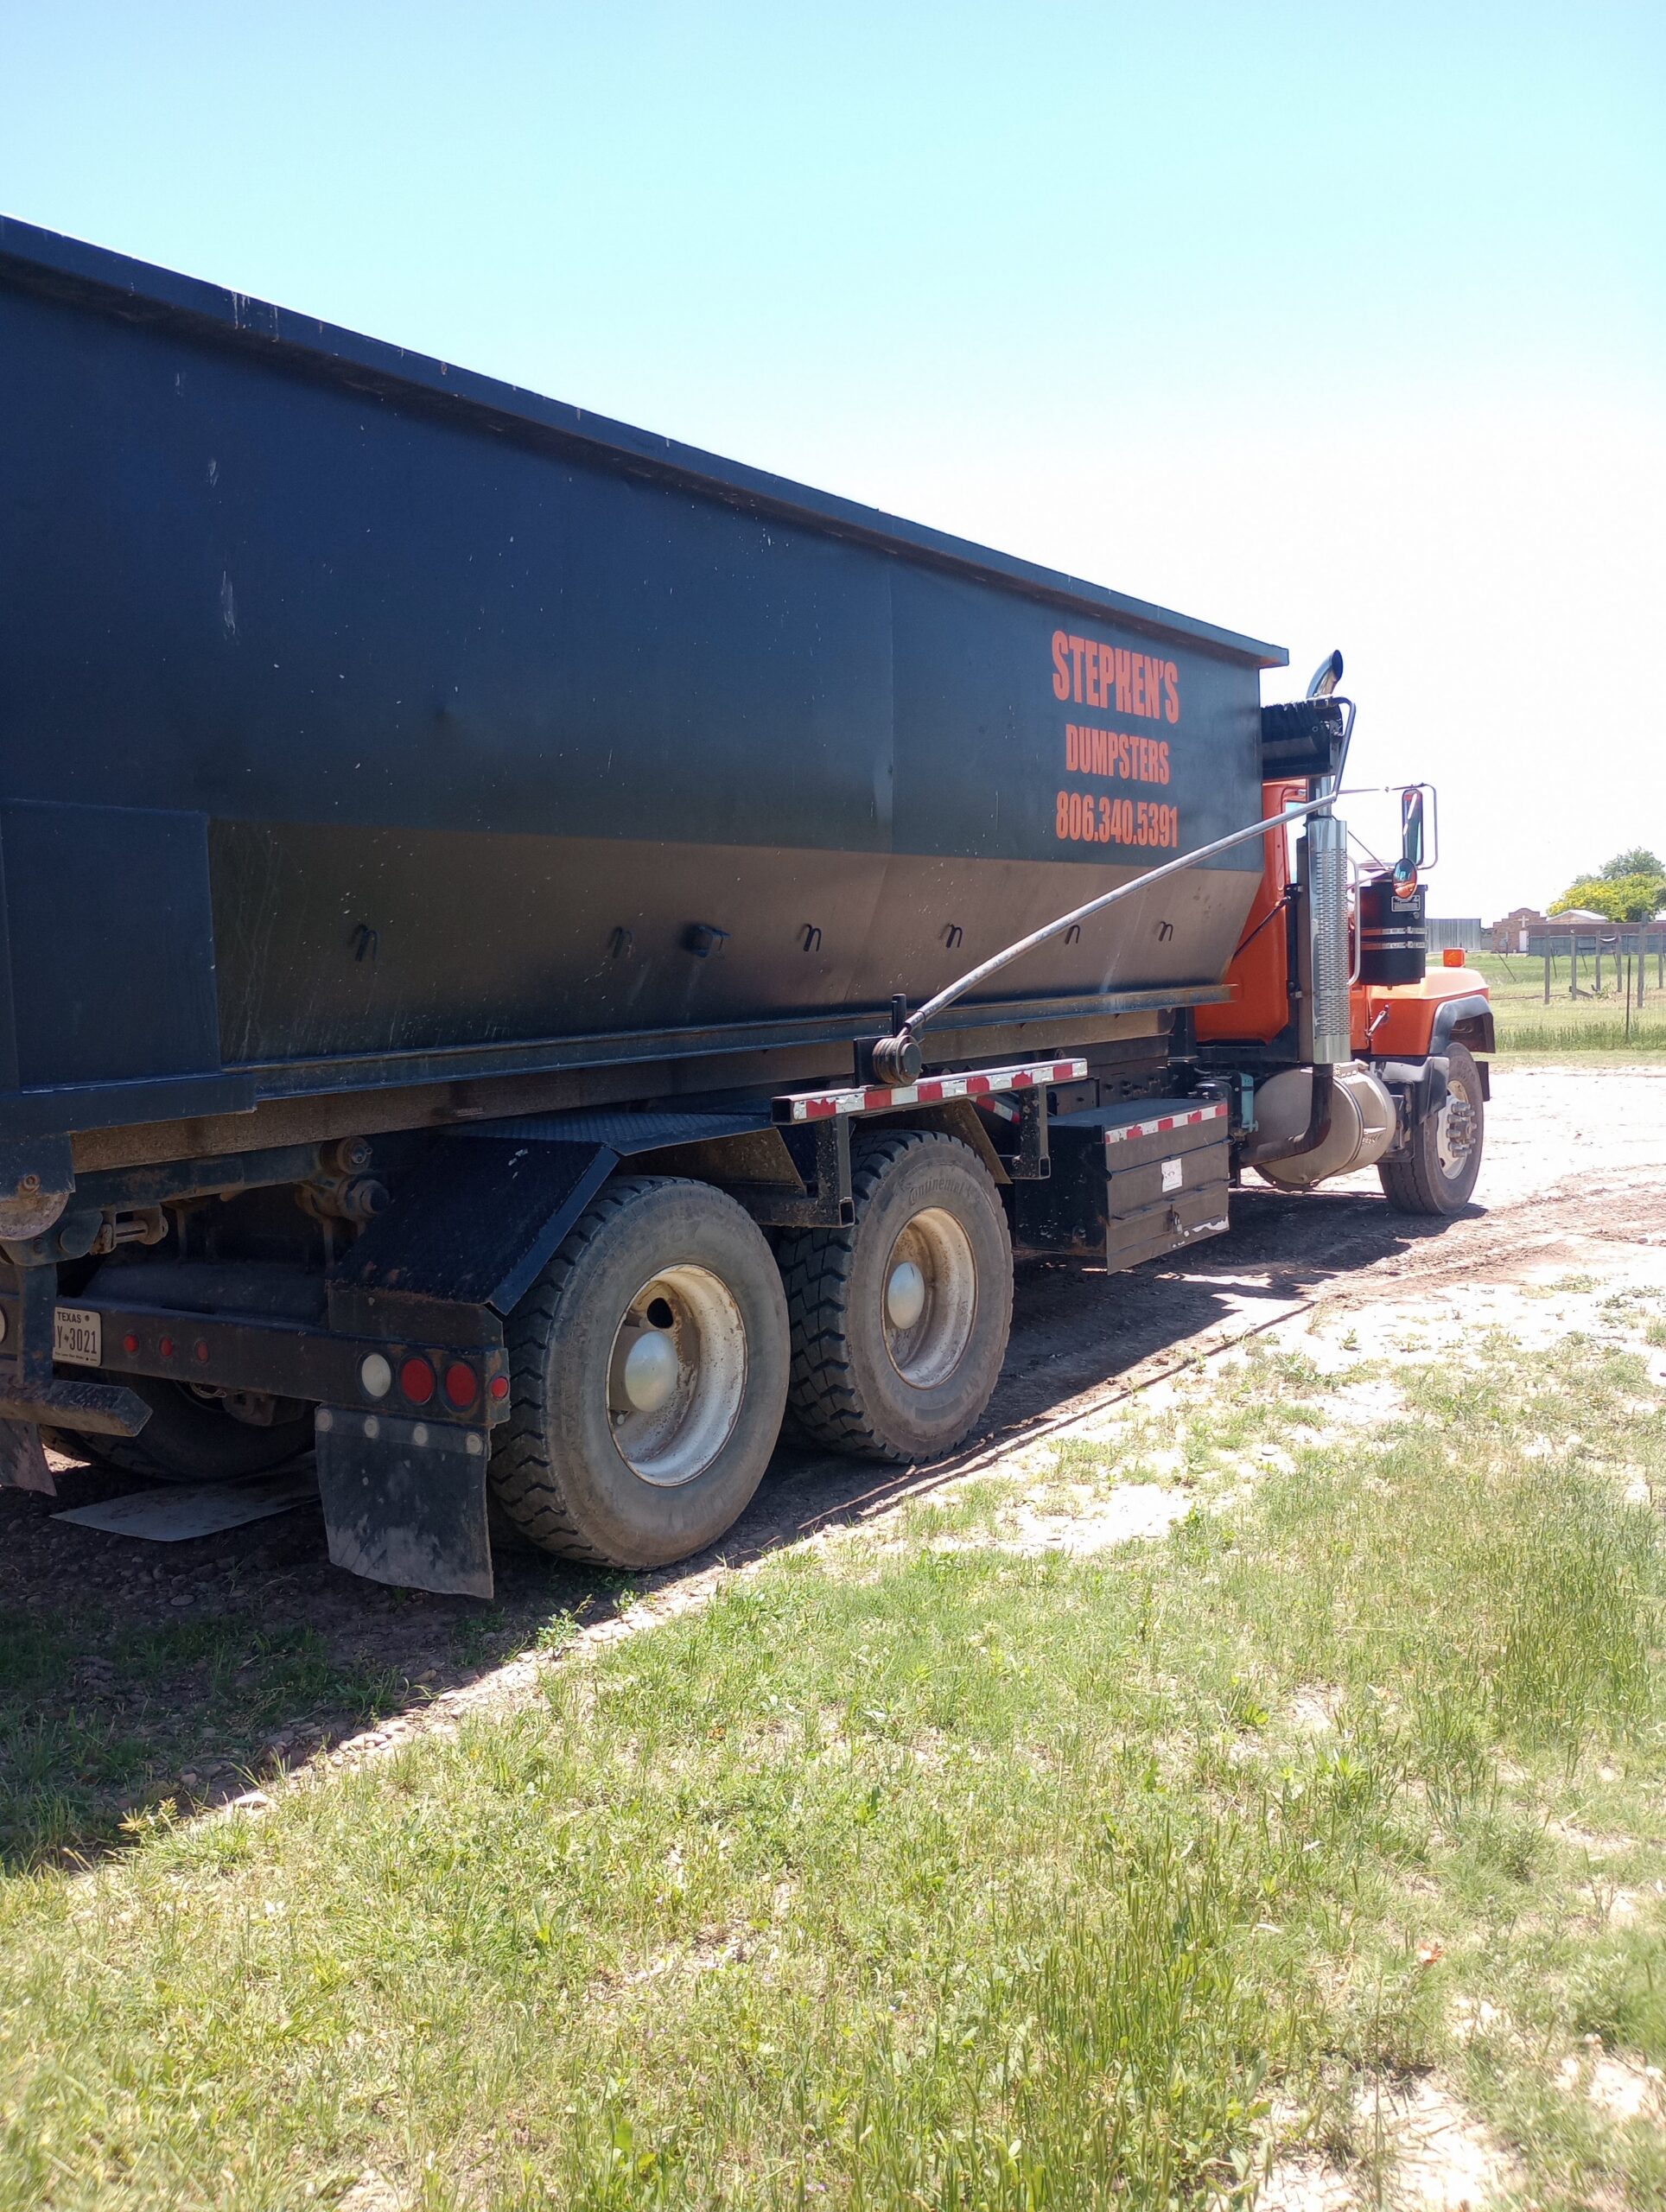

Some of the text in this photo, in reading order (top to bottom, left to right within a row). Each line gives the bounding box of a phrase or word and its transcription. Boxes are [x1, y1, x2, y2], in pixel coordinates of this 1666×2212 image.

[1052, 630, 1180, 724] STEPHEN'S
[1065, 723, 1170, 785] DUMPSTERS
[1056, 791, 1179, 848] 806.340.5391
[56, 1311, 82, 1324] TEXAS
